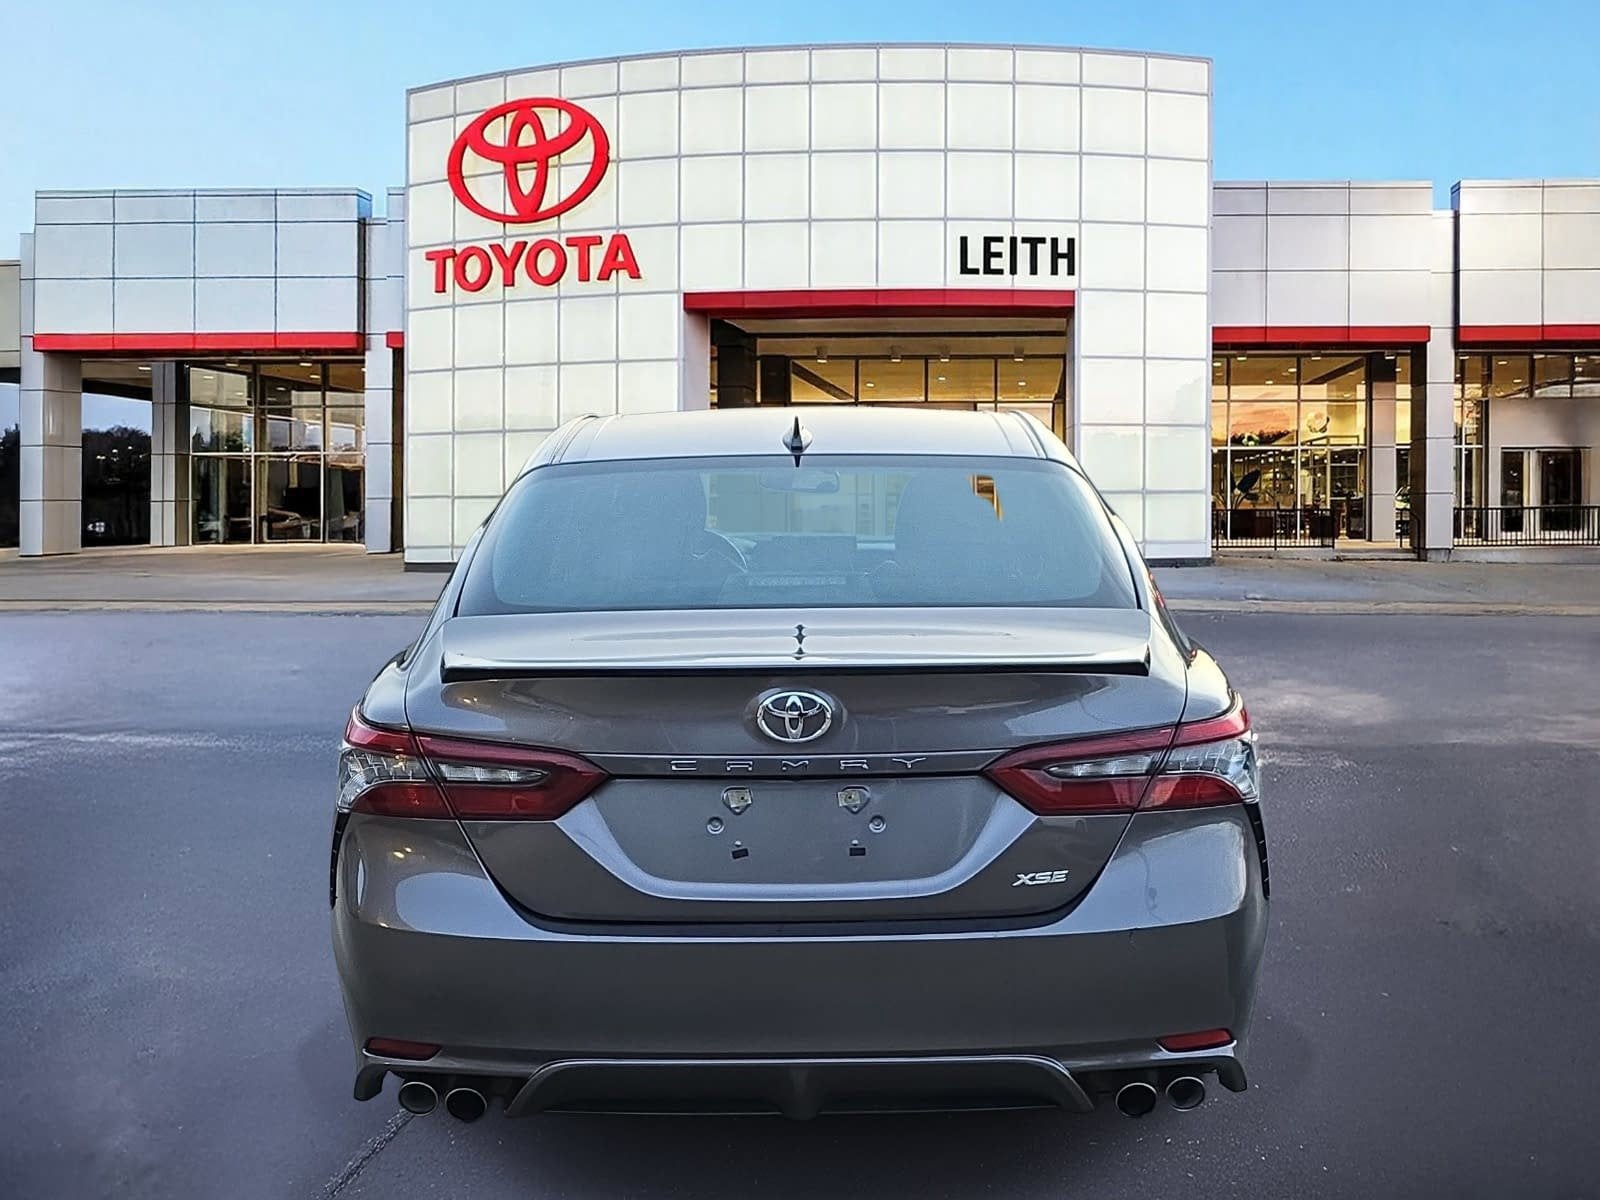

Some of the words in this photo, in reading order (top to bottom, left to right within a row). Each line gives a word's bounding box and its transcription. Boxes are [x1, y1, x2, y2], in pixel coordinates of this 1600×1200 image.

[426, 234, 641, 293] TOYOTA
[959, 236, 1075, 275] LEITH
[670, 757, 926, 772] CAMRY
[1012, 870, 1069, 886] XSE
